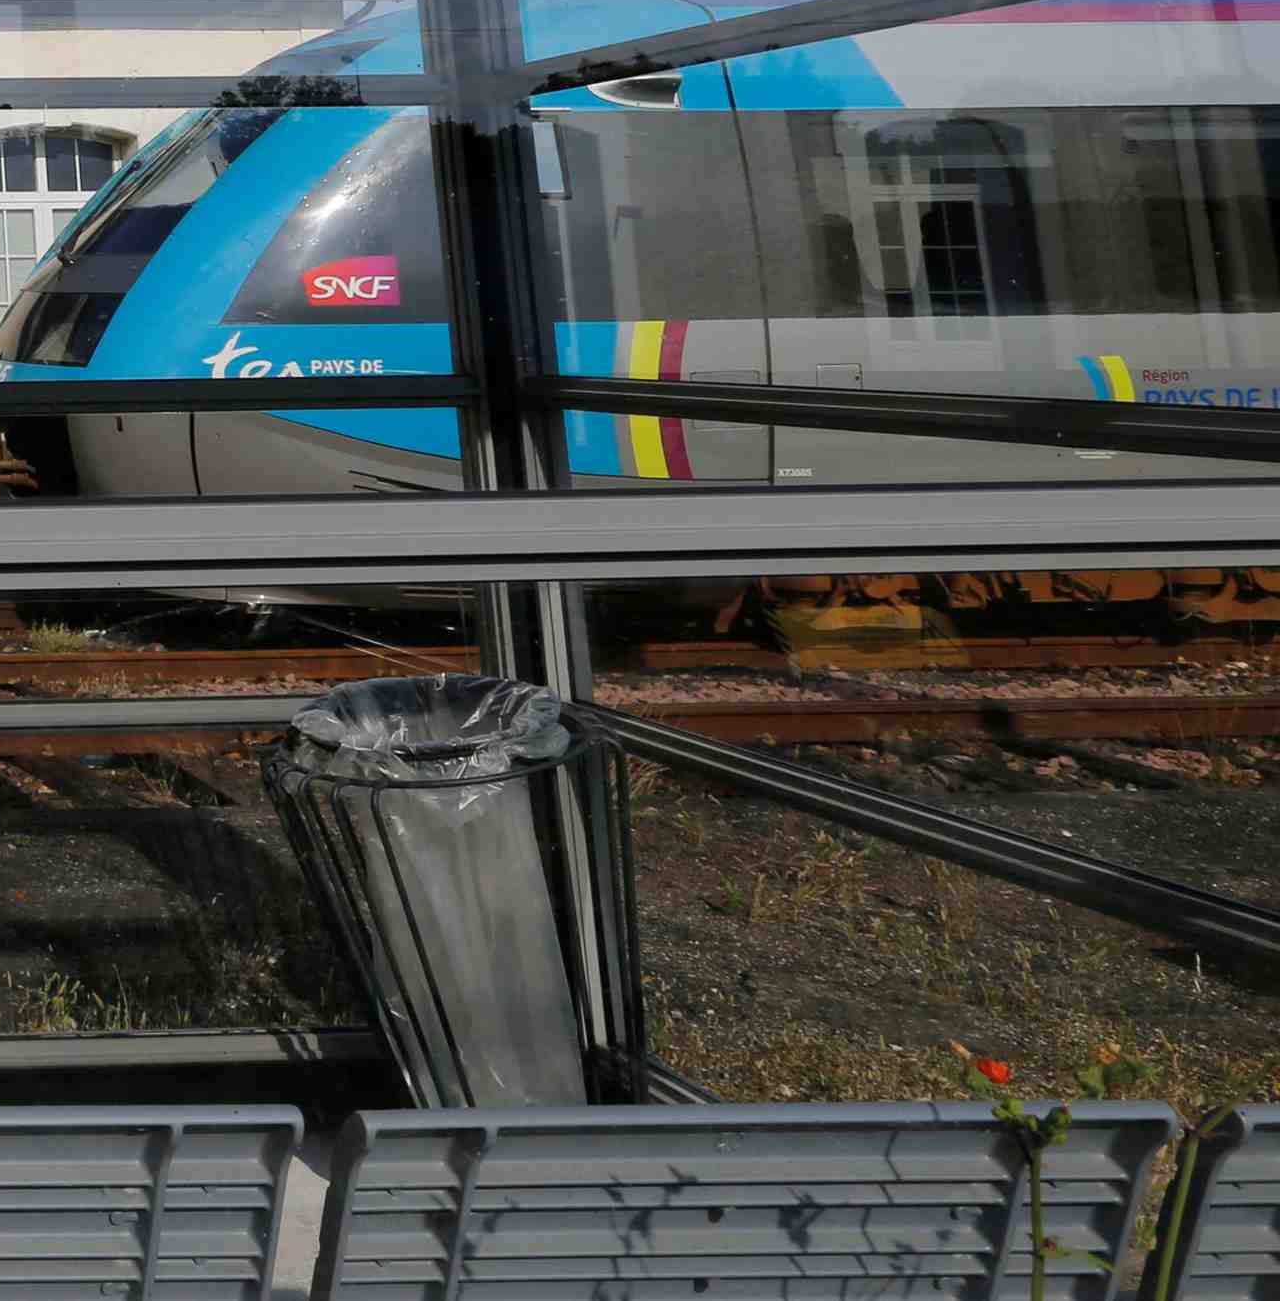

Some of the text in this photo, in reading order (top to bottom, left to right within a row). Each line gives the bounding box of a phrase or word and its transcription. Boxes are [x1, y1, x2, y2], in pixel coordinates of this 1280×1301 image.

[312, 276, 395, 299] SNCF
[311, 359, 384, 375] PAYS DE
[1142, 369, 1190, 384] Région
